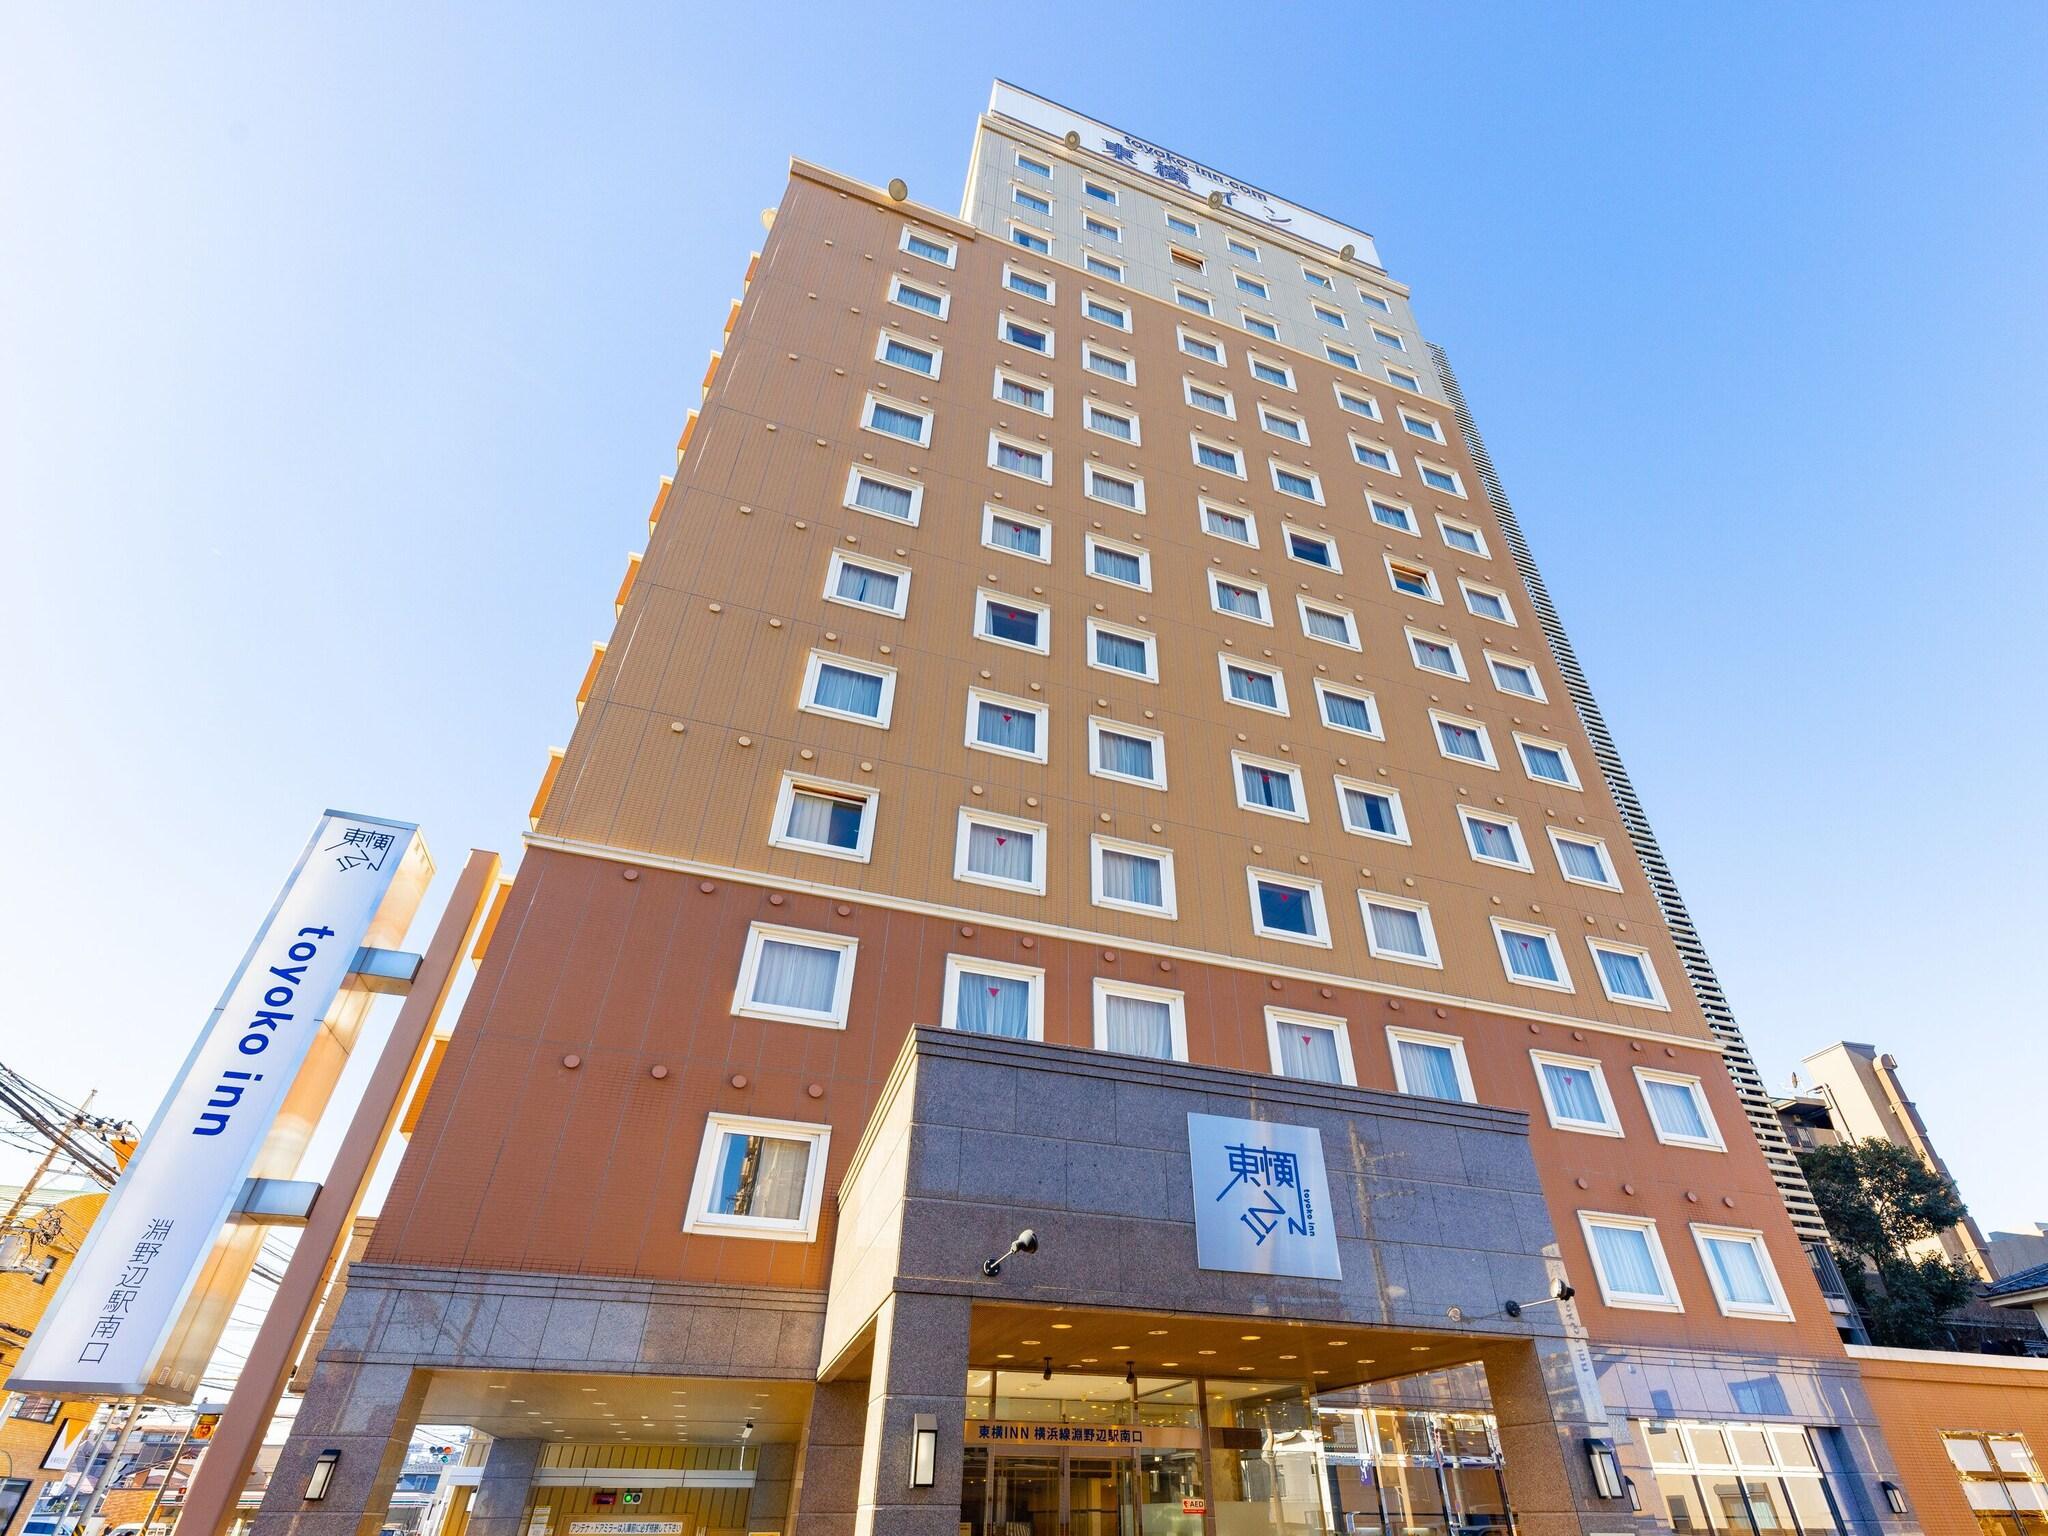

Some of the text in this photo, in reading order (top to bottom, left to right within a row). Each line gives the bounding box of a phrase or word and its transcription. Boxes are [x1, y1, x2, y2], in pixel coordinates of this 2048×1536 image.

[1124, 135, 1268, 202] toyoko-inn.com
[192, 925, 335, 1137] toyoko inn
[1303, 1189, 1313, 1220] toyoko
[78, 1218, 174, 1364] 淵野辺駅南口
[978, 1425, 1143, 1443] 東横INN 横浜線淵野辺駅南口
